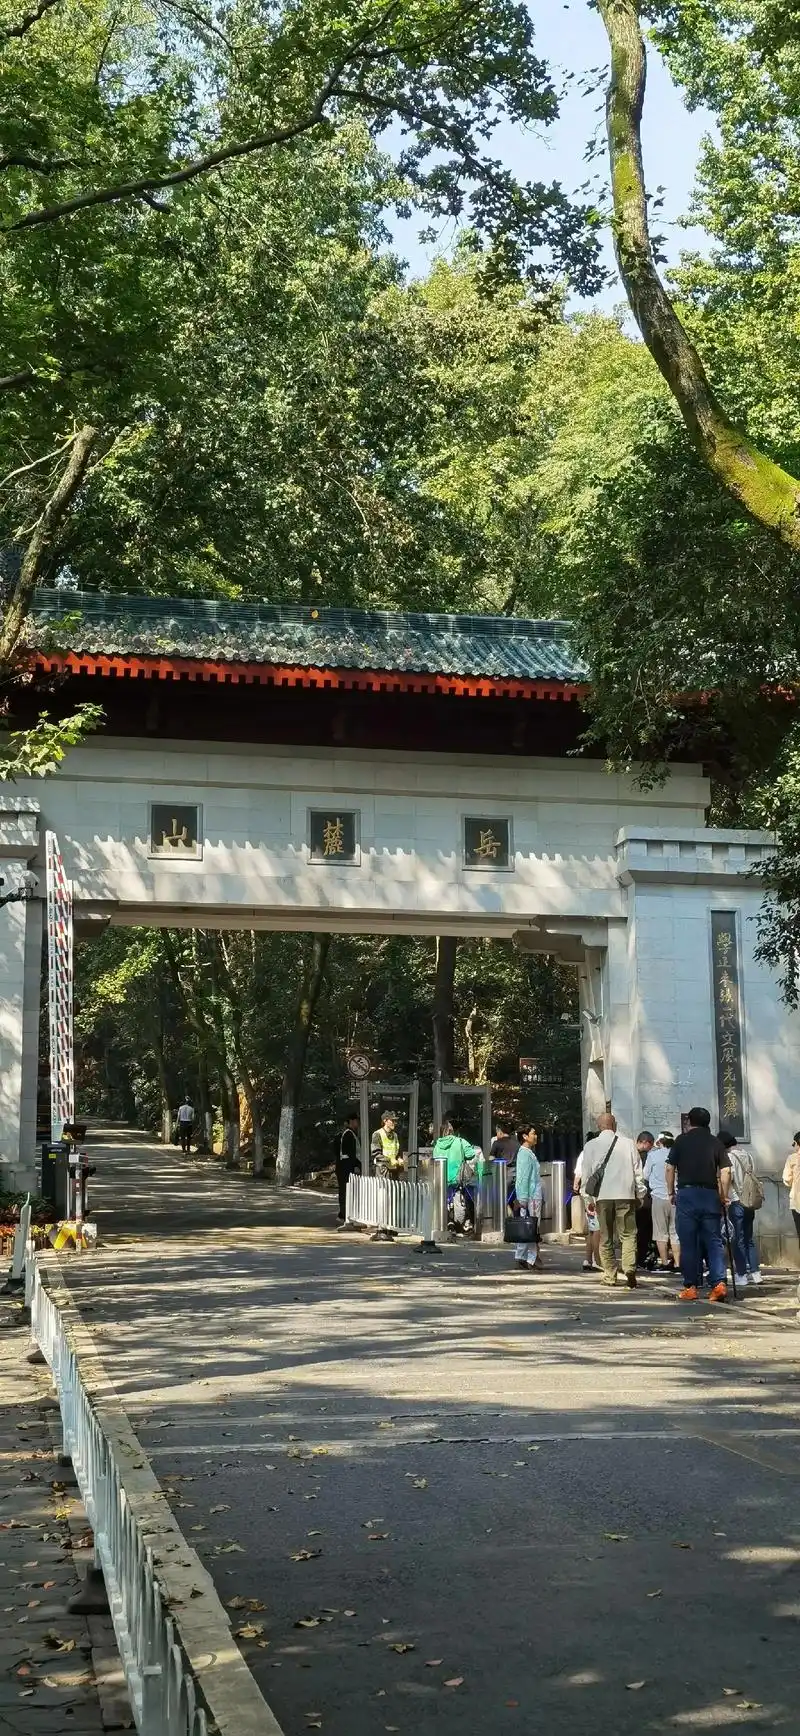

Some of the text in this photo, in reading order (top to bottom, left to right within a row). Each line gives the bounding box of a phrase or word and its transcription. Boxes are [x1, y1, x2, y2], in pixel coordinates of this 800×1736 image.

[161, 817, 501, 858] 岳 麓 山
